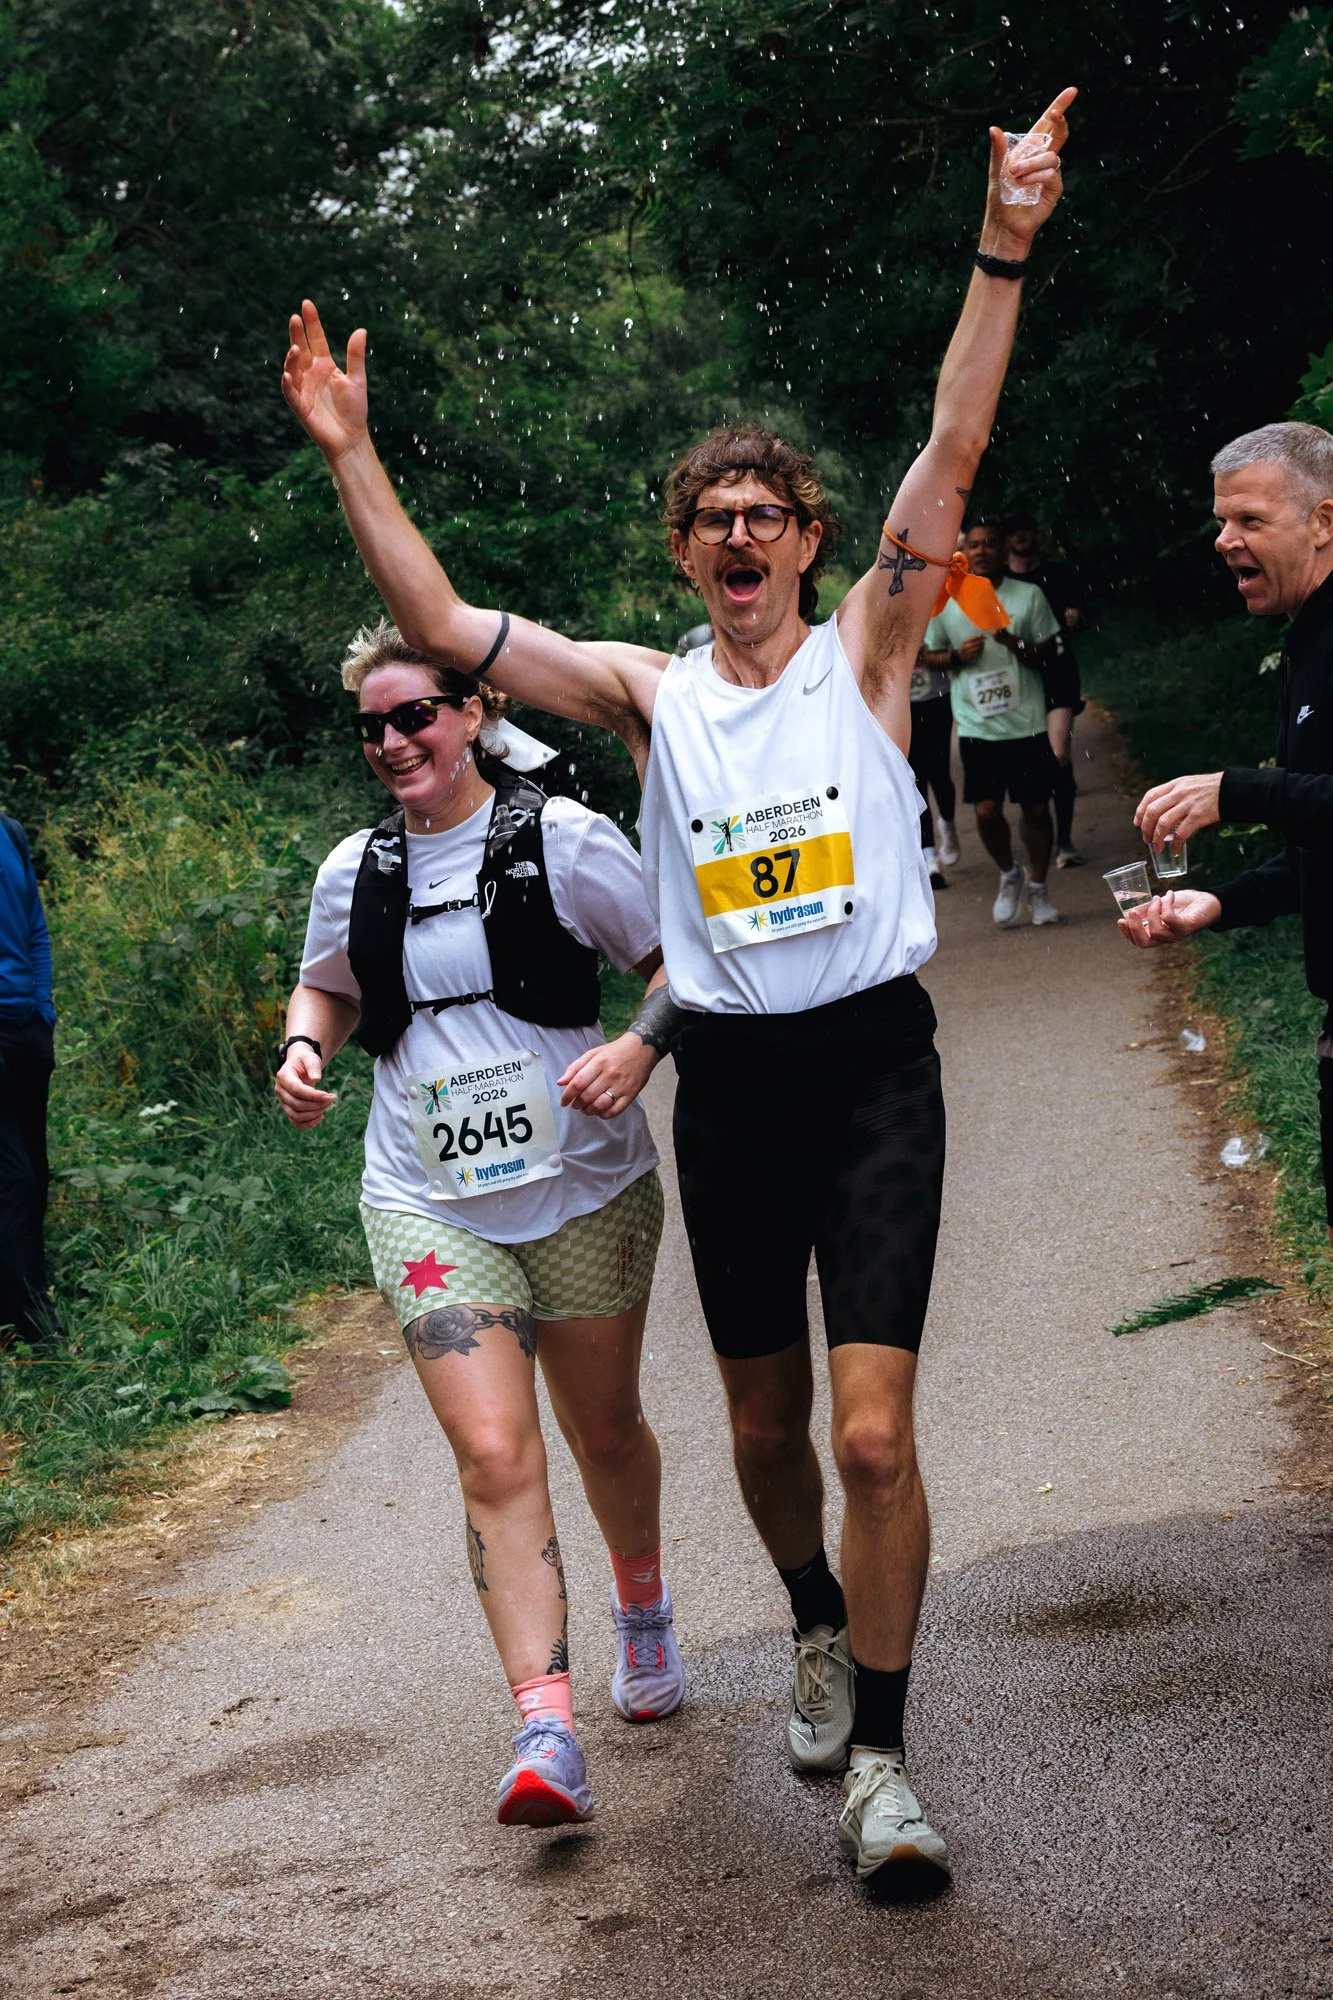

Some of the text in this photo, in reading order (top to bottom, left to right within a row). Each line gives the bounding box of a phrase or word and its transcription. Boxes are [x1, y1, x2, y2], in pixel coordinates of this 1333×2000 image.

[977, 685, 1012, 704] 2798
[745, 796, 821, 825] ABERDEEN
[745, 810, 823, 835] HALF MARATHON
[769, 825, 806, 843] 2026
[505, 866, 529, 875] NORTH
[512, 871, 529, 879] FACE
[750, 848, 800, 898] 87
[769, 901, 824, 925] hydrasun
[450, 1060, 522, 1088] ABERDEEN
[451, 1073, 524, 1097] HALF MARATHON
[472, 1087, 508, 1105] 2026
[433, 1103, 533, 1162] 2645
[474, 1158, 526, 1181] hydrasun
